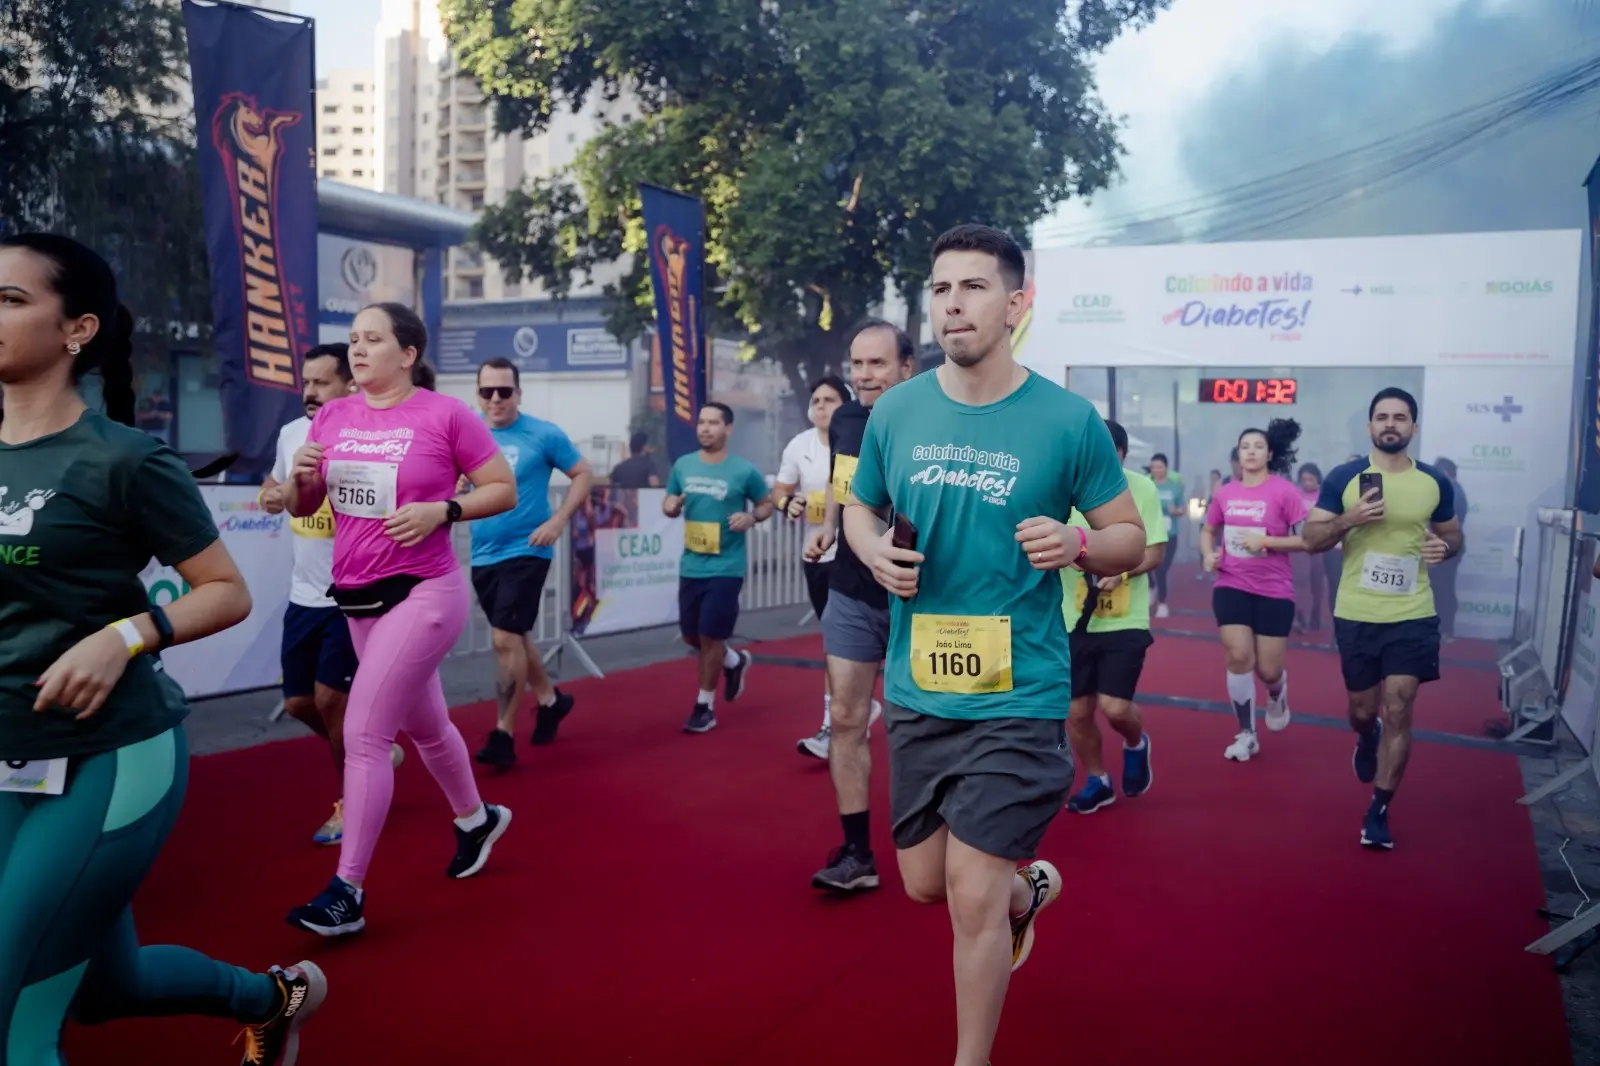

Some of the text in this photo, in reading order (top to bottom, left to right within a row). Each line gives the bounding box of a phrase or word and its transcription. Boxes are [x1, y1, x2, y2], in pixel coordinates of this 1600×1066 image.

[237, 157, 295, 385] HANKER
[1166, 272, 1313, 293] Colorindo a vida
[1073, 295, 1112, 308] CEAD
[1180, 299, 1312, 330] Diabetes!
[912, 443, 1020, 472] Colorindo a vida
[1472, 444, 1512, 458] CEAD
[920, 464, 1017, 497] Diabetes!
[338, 486, 376, 506] 5166
[618, 533, 662, 558] CEAD
[1371, 570, 1405, 587] 5313
[935, 640, 972, 649] João Lima
[928, 651, 982, 677] 1160
[284, 985, 307, 1017] CORRE
